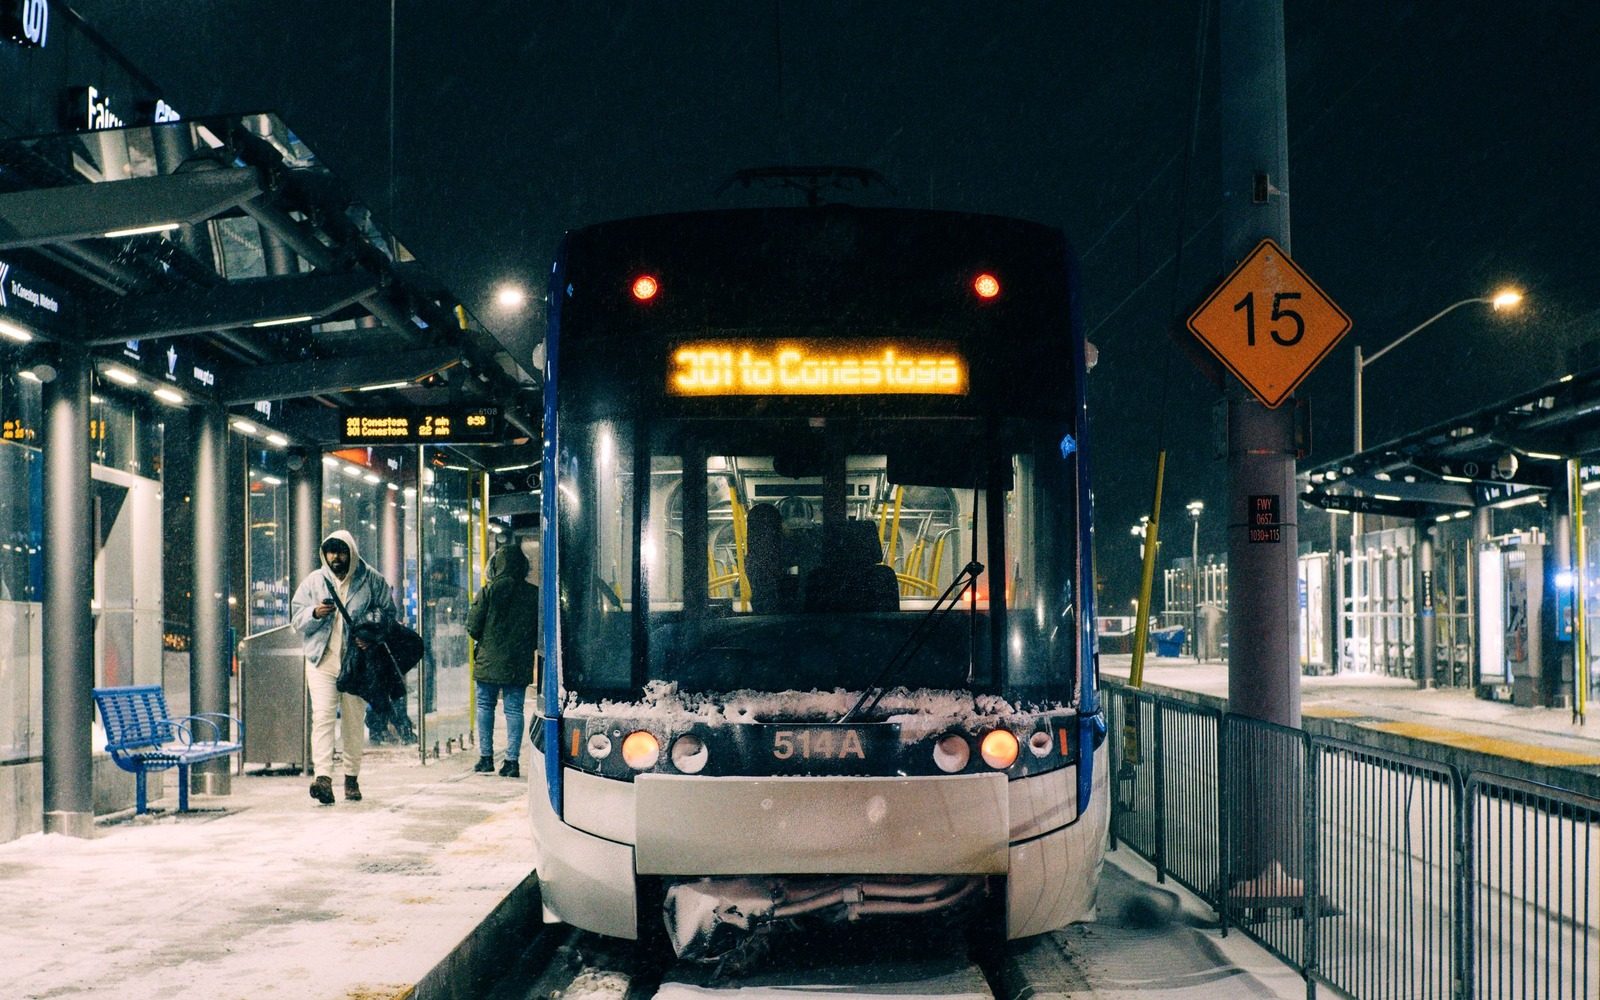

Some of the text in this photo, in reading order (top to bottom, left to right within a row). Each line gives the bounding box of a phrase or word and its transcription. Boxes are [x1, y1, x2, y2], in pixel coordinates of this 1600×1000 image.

[1233, 291, 1305, 347] 15
[675, 349, 959, 387] 301 to Conestoga
[425, 416, 433, 426] 7
[435, 416, 450, 426] min
[419, 426, 433, 436] 22
[435, 426, 450, 435] min
[1257, 498, 1272, 511] FWY
[1250, 529, 1280, 541] 1030+115
[773, 729, 865, 760] 514A
